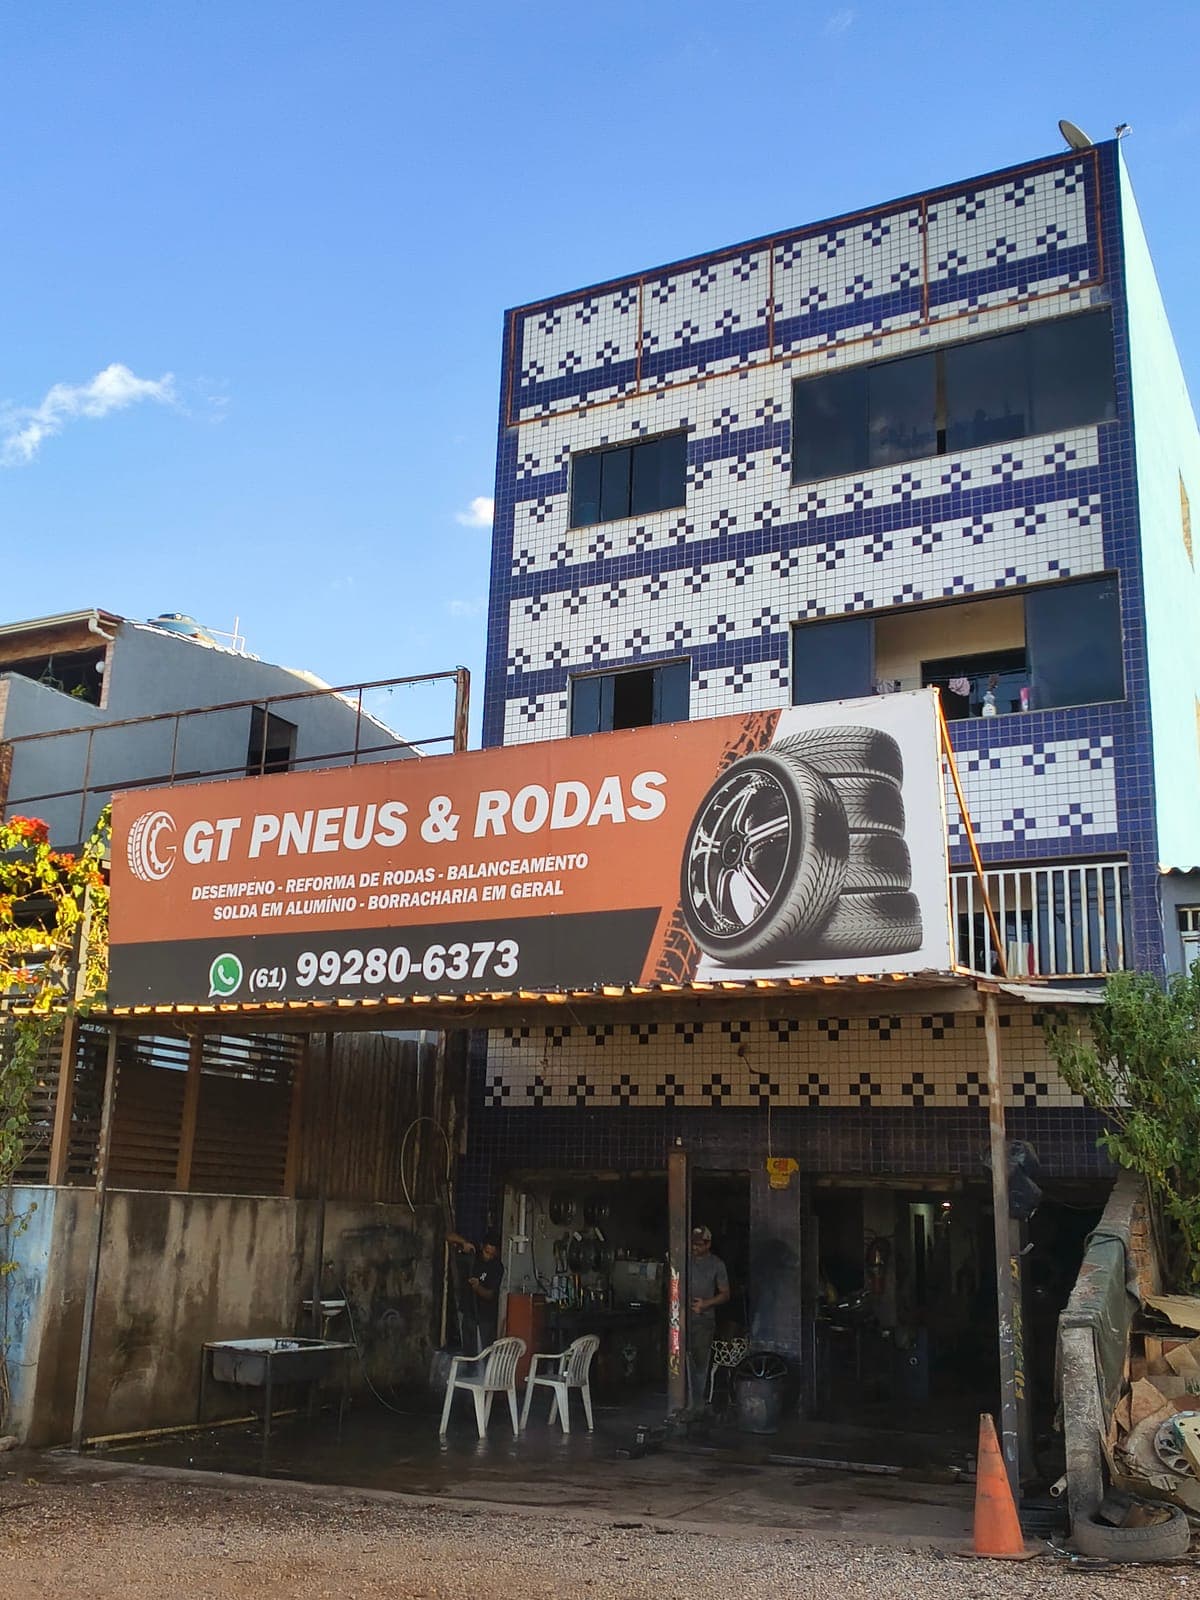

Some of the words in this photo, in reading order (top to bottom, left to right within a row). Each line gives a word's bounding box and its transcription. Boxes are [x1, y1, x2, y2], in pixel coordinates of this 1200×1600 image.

[183, 817, 242, 865] GT
[248, 801, 409, 859] PNEUS
[420, 795, 460, 843] &
[473, 770, 668, 838] RODAS
[191, 880, 276, 901] DESEMPENO
[285, 874, 356, 893] REFORMA
[359, 872, 381, 888] DE
[382, 867, 436, 886] RODAS
[446, 853, 589, 881] BALANCEAMENTO
[213, 903, 258, 921] SOLDA
[260, 901, 284, 917] EM
[285, 895, 357, 916] ALUMÍNIO
[367, 887, 478, 910] BORRACHARIA
[481, 884, 507, 902] EM
[510, 879, 564, 899] GERAL
[248, 967, 287, 993] (61)
[295, 939, 519, 987] 99280-6373
